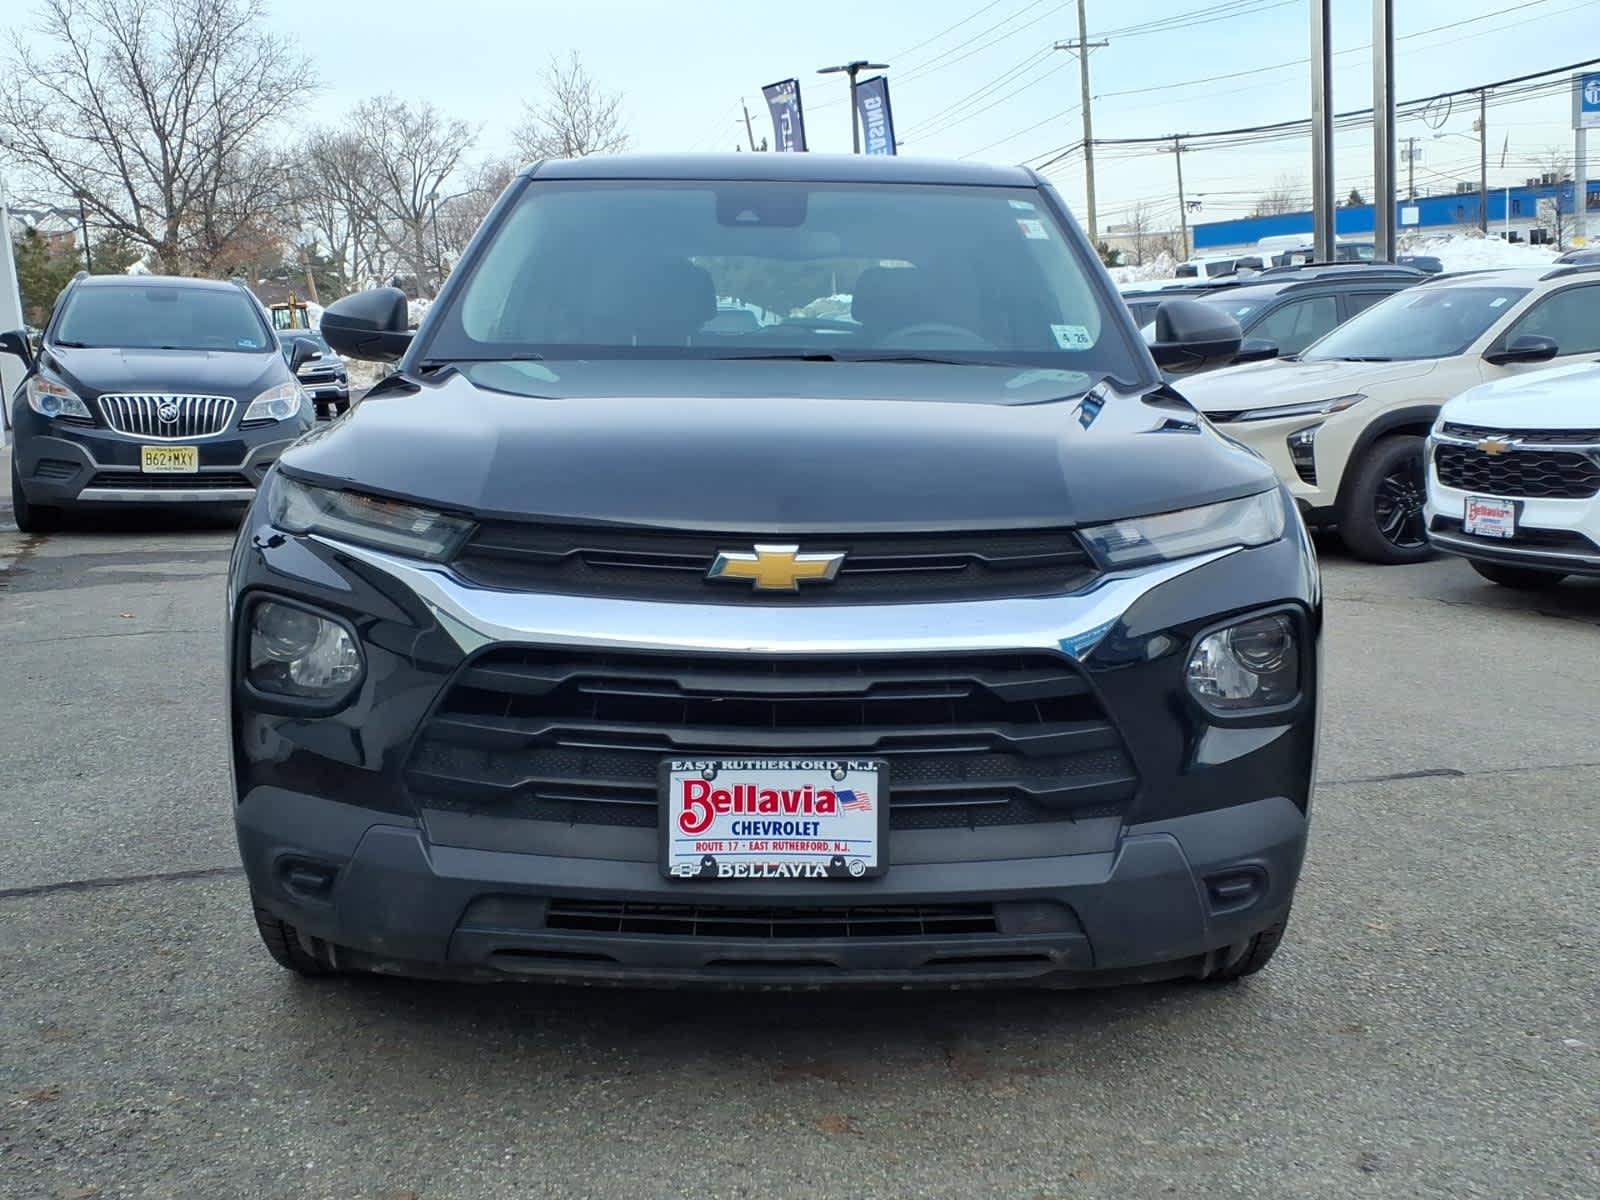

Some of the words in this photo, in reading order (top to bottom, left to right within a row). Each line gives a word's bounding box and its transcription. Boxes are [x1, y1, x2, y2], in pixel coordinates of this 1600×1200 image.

[671, 760, 717, 771] EAST
[847, 760, 878, 770] N.J.
[678, 778, 838, 836] Bellavia
[731, 821, 820, 836] CHEVROLET
[696, 842, 723, 852] ROUTE
[728, 842, 738, 852] 17
[749, 842, 769, 852] EAST
[834, 842, 850, 852] N.J.
[717, 862, 829, 878] BELLAVIA
